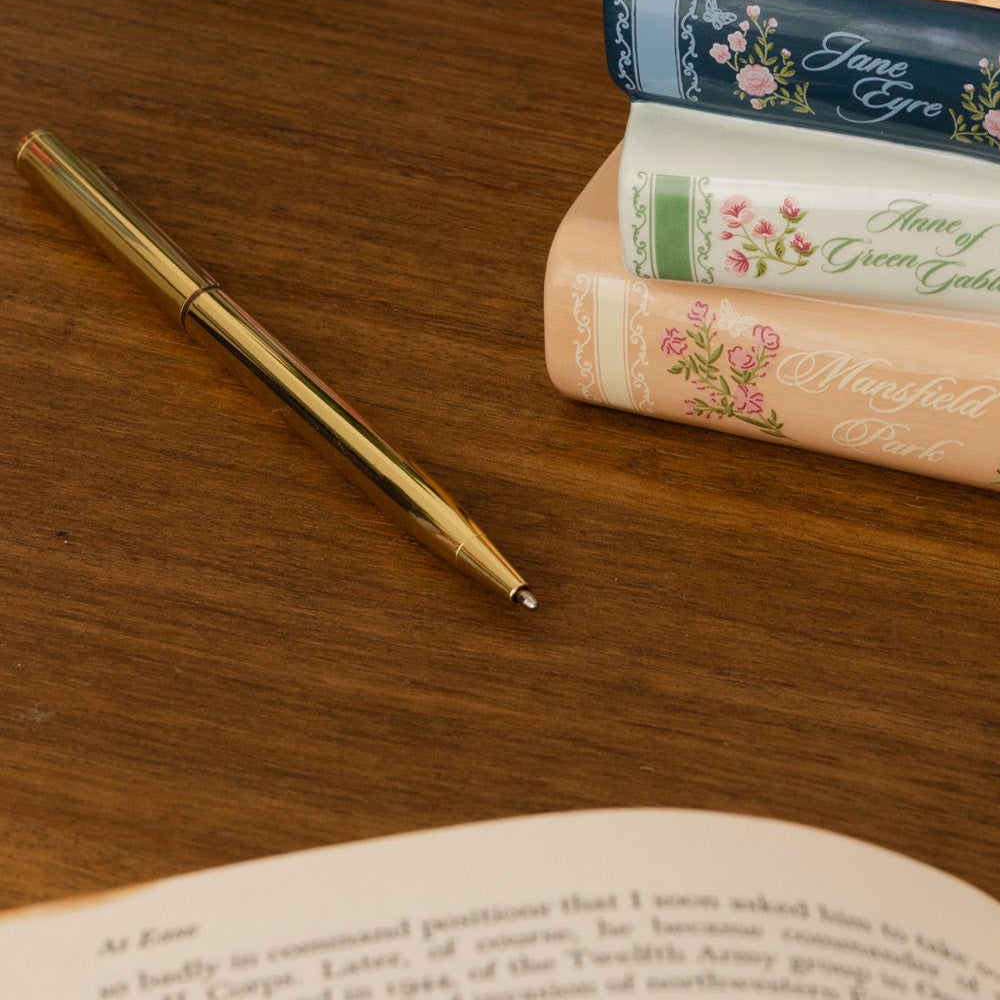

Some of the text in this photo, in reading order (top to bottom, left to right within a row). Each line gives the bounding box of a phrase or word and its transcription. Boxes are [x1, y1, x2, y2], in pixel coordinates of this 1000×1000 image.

[801, 30, 909, 78] Jane
[836, 76, 943, 124] Eyre
[866, 198, 962, 234] Anne
[821, 236, 919, 274] Green
[831, 417, 965, 463] Park
[265, 917, 411, 963] command
[420, 902, 551, 941] positions
[560, 892, 618, 916] that
[630, 889, 642, 911] I
[650, 914, 765, 938] became
[507, 952, 556, 975] the
[695, 943, 777, 975] Army
